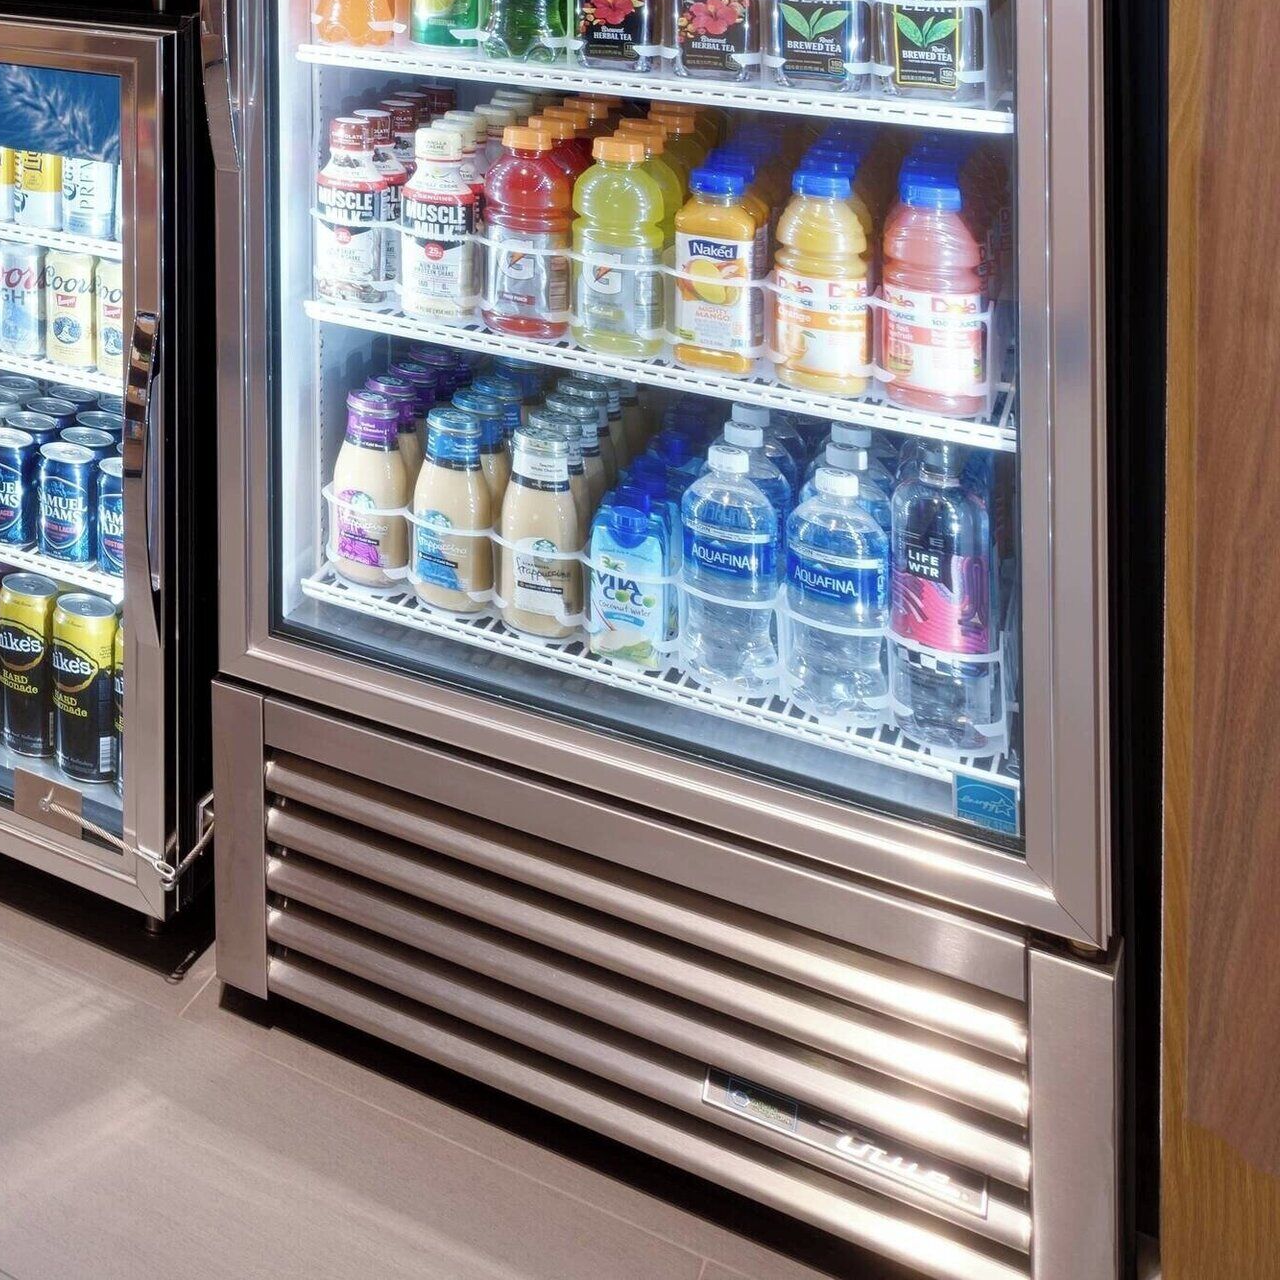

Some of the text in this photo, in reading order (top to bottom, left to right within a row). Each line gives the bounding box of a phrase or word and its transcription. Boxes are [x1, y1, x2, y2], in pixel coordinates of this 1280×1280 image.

[593, 31, 632, 41] HERBAL TEA
[692, 41, 735, 53] HERBAL TEA
[787, 40, 842, 53] BREWED TEA
[902, 50, 953, 62] BREWED TEA
[405, 202, 467, 224] MUSCLE
[691, 542, 751, 571] AQUAFINA
[907, 548, 939, 565] LIFE
[907, 561, 939, 578] WTR
[596, 572, 640, 596] VITA
[794, 565, 856, 595] AQUAFINA
